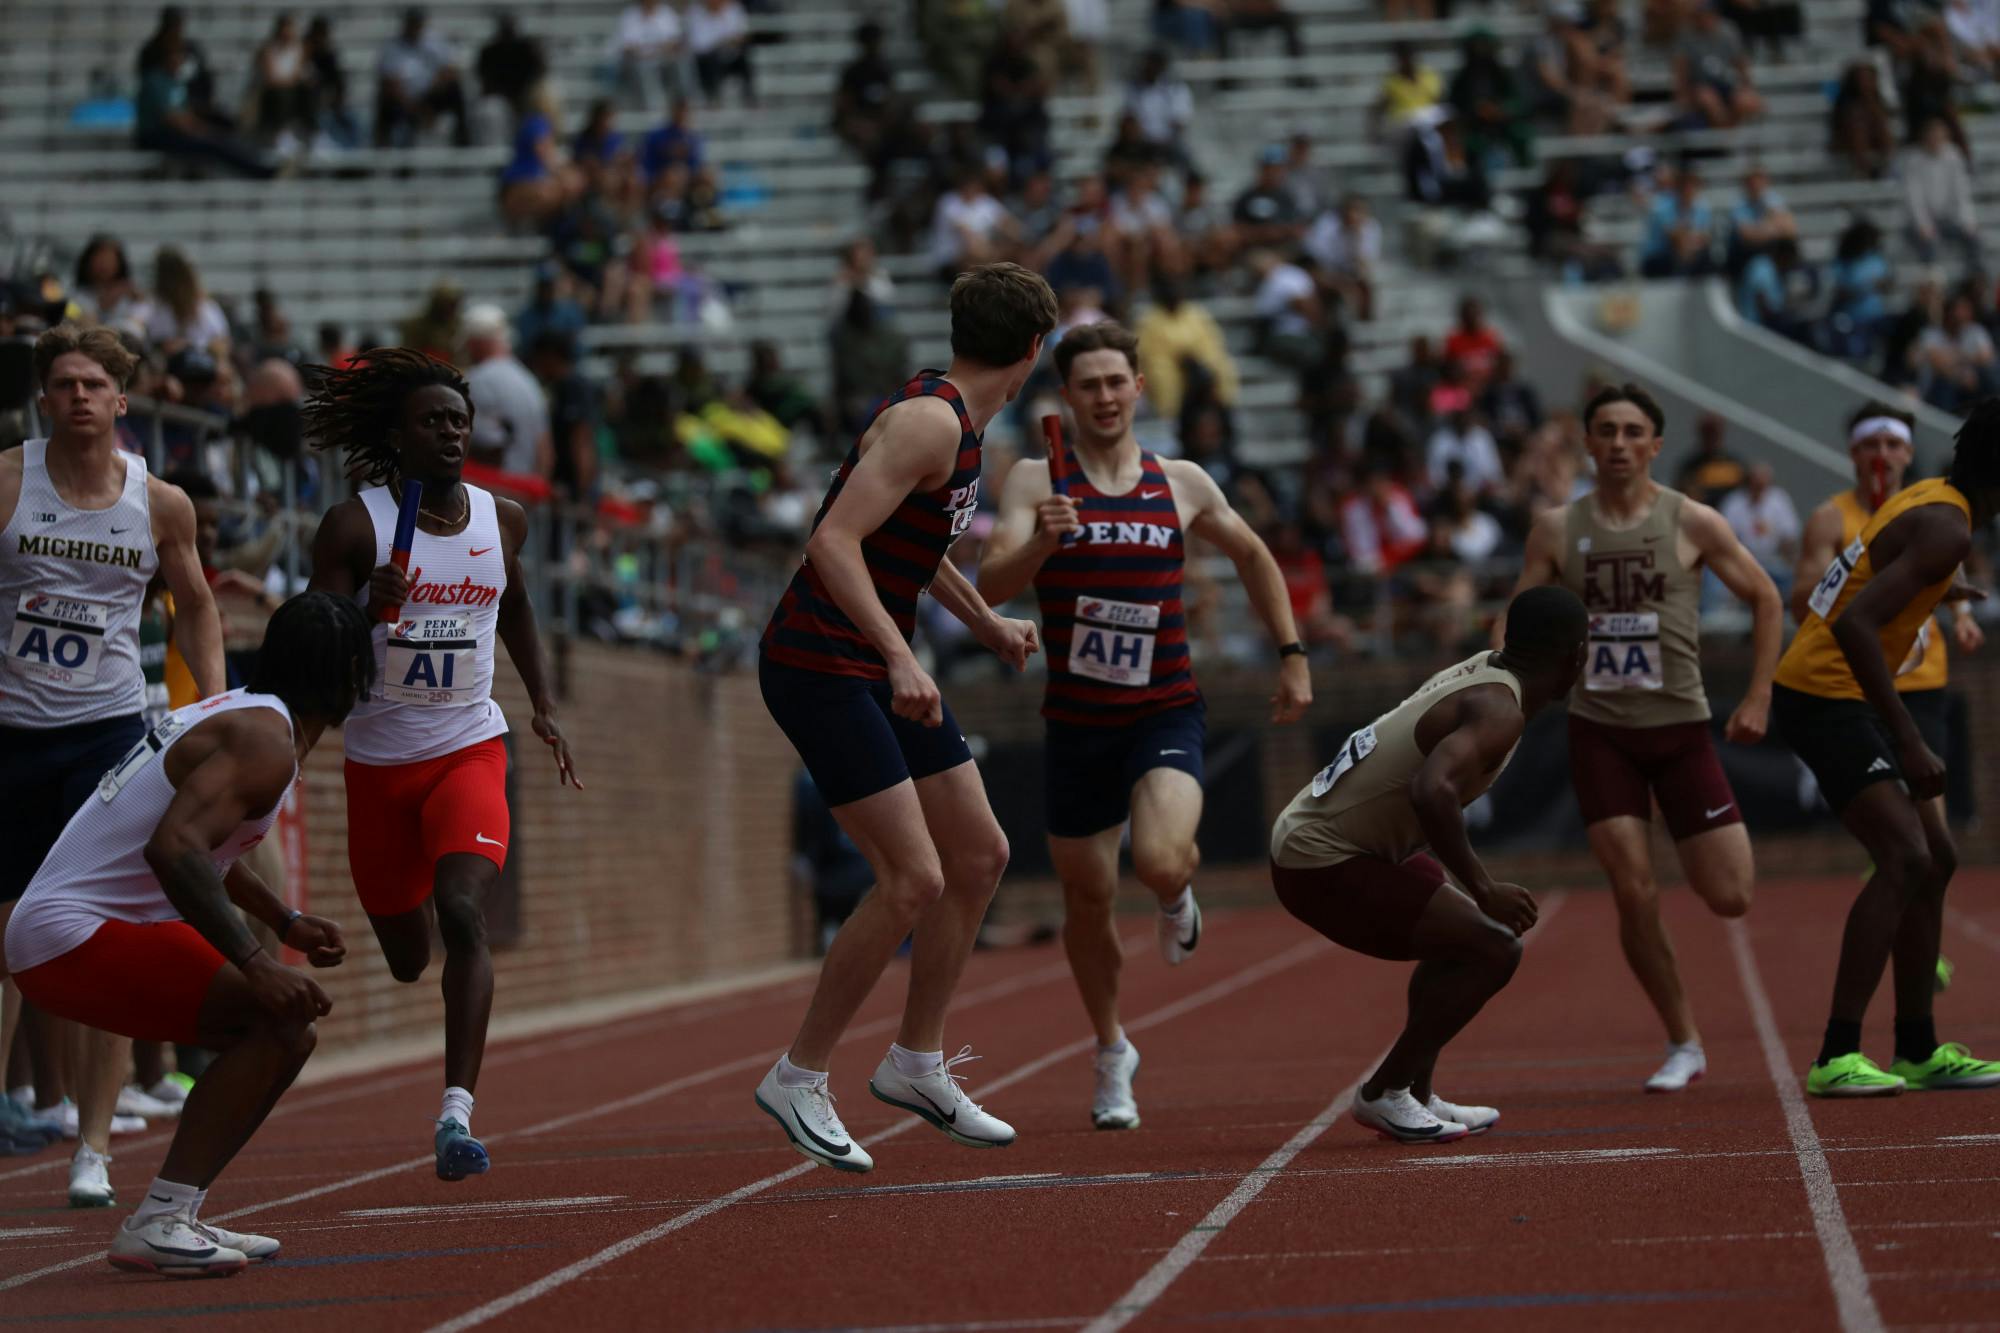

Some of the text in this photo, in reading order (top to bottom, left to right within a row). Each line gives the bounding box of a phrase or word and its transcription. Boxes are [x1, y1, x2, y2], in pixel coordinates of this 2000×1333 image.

[18, 535, 142, 568] MICHIGAN
[53, 607, 98, 623] RELAYS
[57, 599, 90, 612] PENN
[422, 628, 467, 638] RELAYS
[424, 619, 458, 629] PENN
[16, 627, 89, 669] AO
[1078, 630, 1143, 668] AH
[1594, 645, 1652, 674] AA
[402, 653, 455, 688] AI
